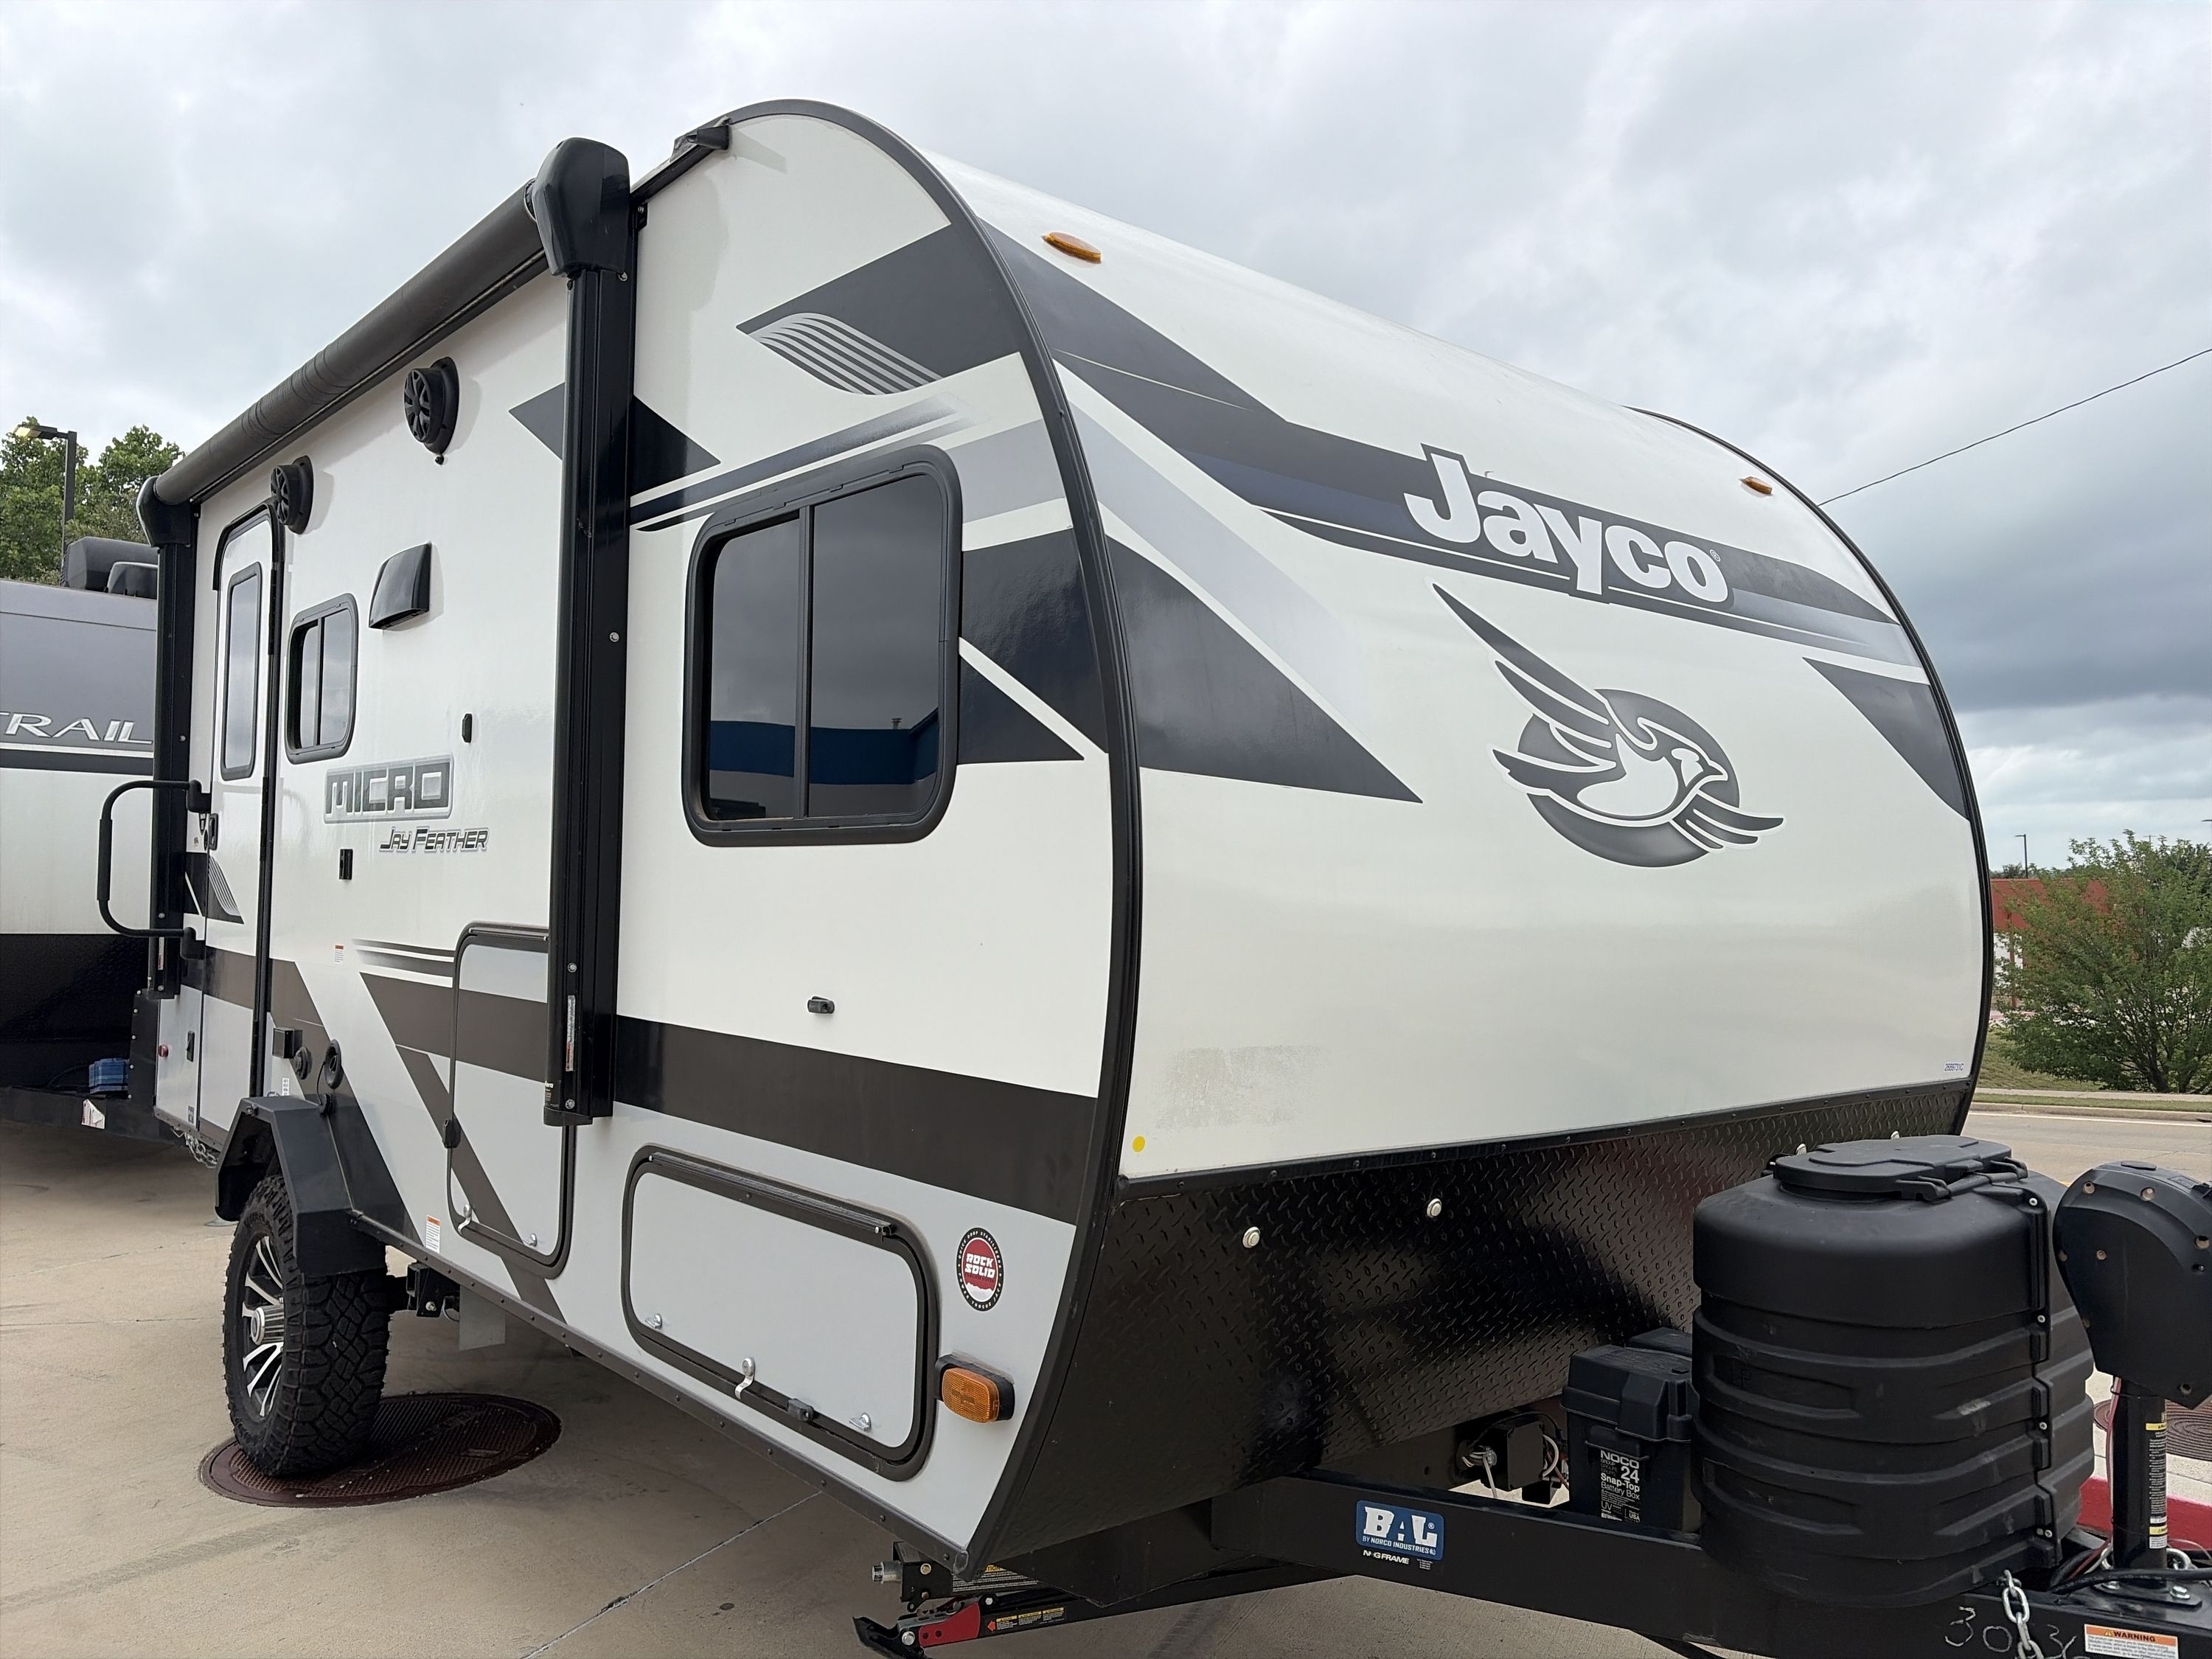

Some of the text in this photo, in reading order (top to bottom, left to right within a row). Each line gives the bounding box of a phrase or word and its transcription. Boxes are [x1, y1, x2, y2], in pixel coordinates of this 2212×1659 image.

[1403, 452, 1729, 603] Jayco
[0, 711, 153, 745] RAIL
[324, 762, 451, 815] MICRO
[412, 828, 490, 850] FEATHER
[966, 1253, 995, 1267] ROCK
[964, 1263, 995, 1279] SOLID
[1601, 1450, 1640, 1470] NOCO
[1601, 1472, 1641, 1493] Snap-Top
[1621, 1465, 1640, 1484] 24
[1601, 1481, 1640, 1500] Battery Box
[1601, 1500, 1613, 1511] UV
[1363, 1506, 1438, 1548] BAL
[1371, 1537, 1392, 1547] NORCO
[1393, 1541, 1429, 1554] INDUSTRIES
[1381, 1553, 1410, 1564] FRAME
[2113, 1631, 2156, 1642] WARNING
